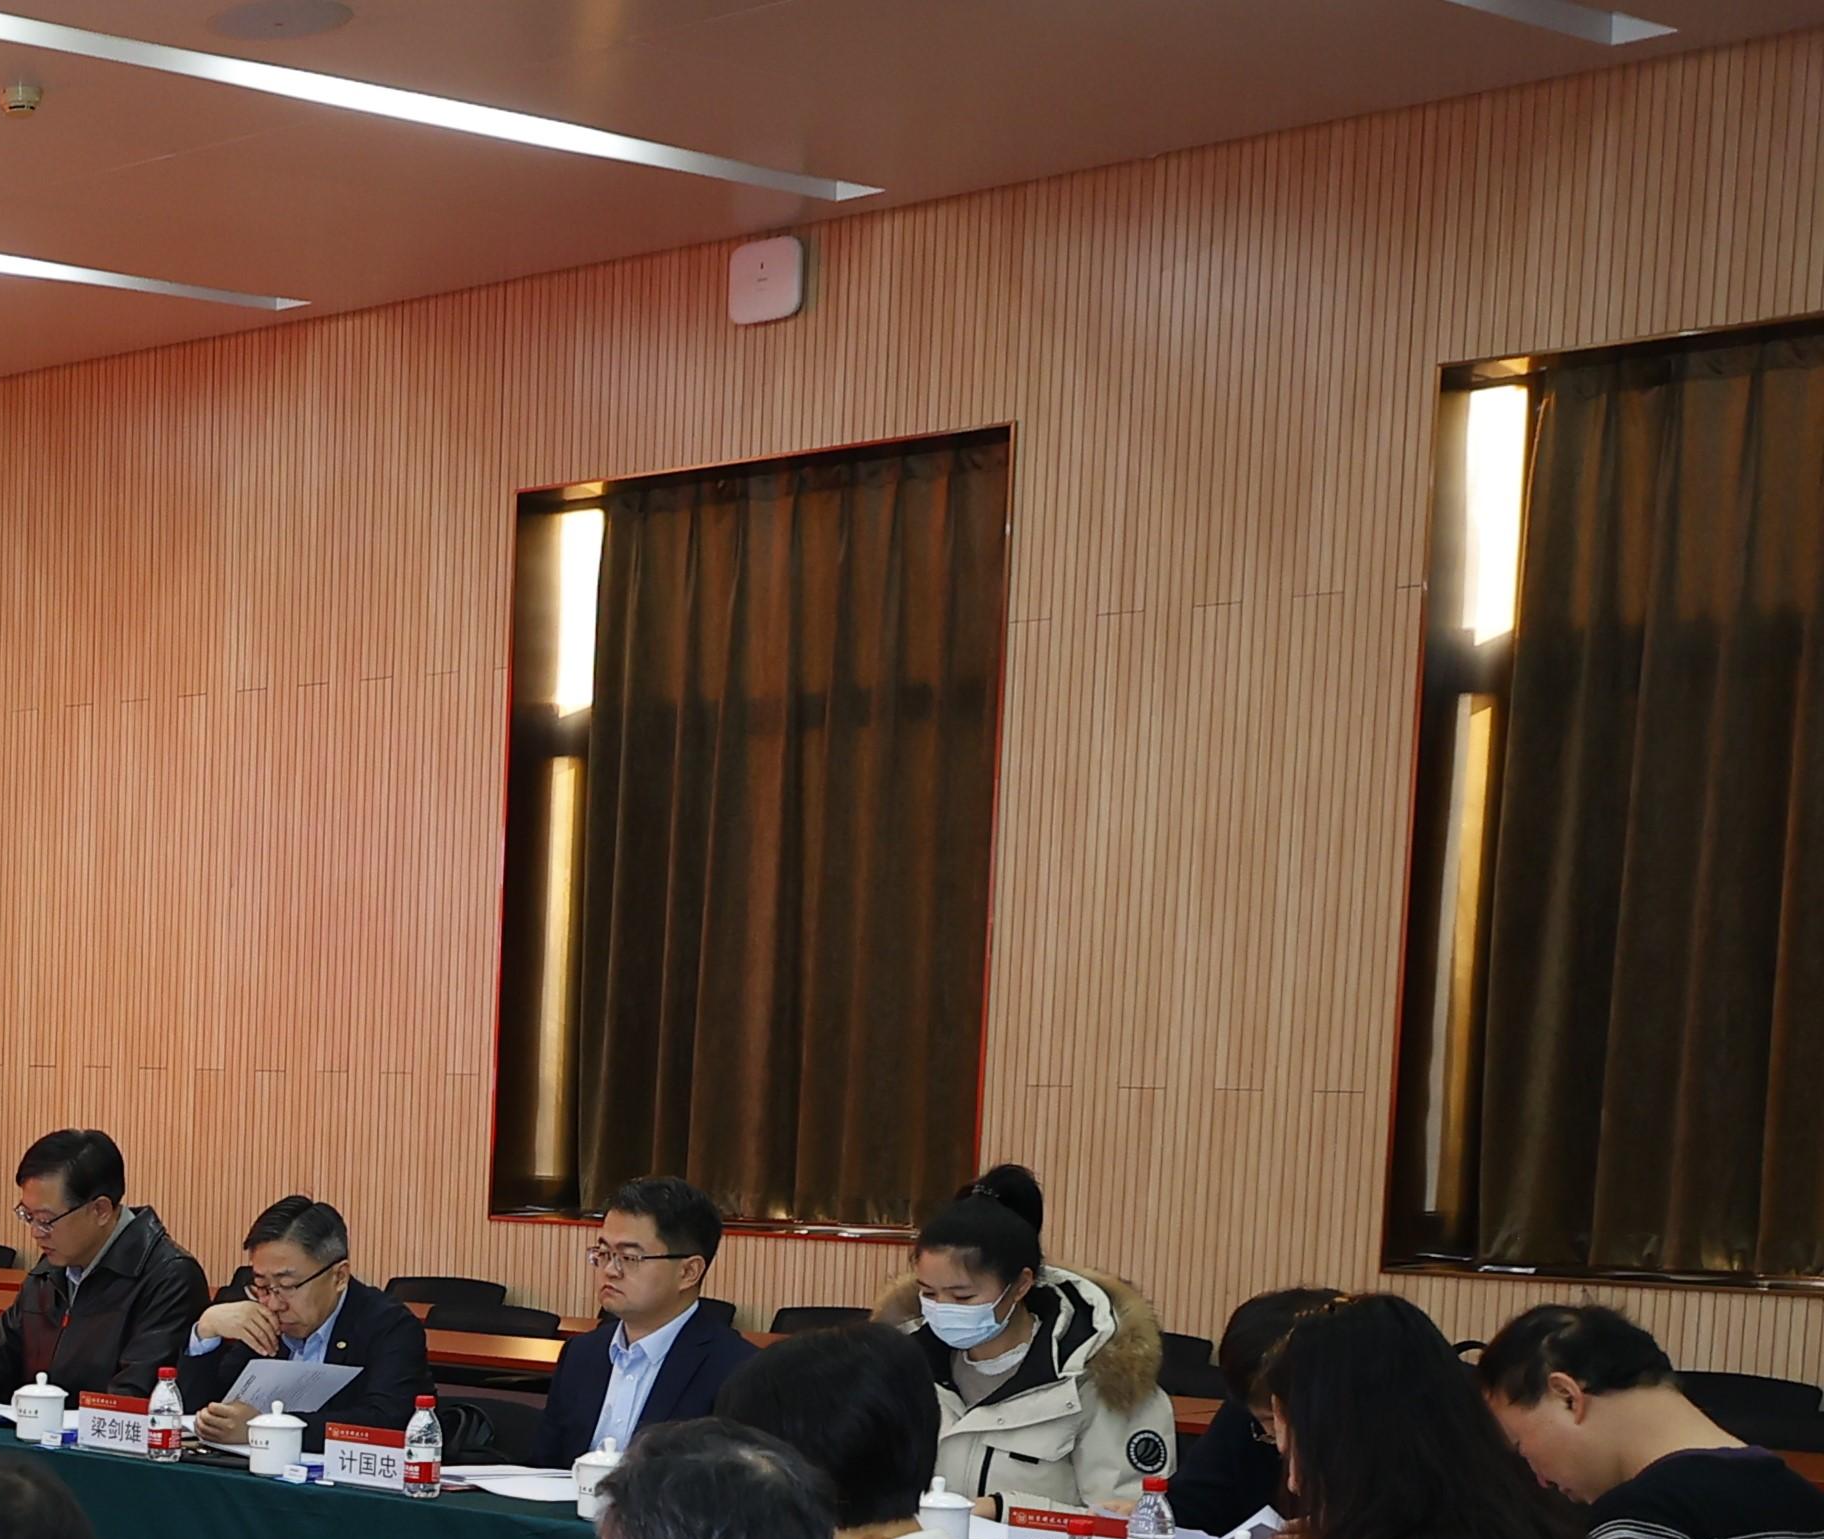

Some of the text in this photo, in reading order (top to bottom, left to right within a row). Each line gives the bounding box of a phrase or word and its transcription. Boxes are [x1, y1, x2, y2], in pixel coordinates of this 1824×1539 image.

[91, 1416, 141, 1443] 梁剑雄
[339, 1450, 397, 1479] 计国忠
